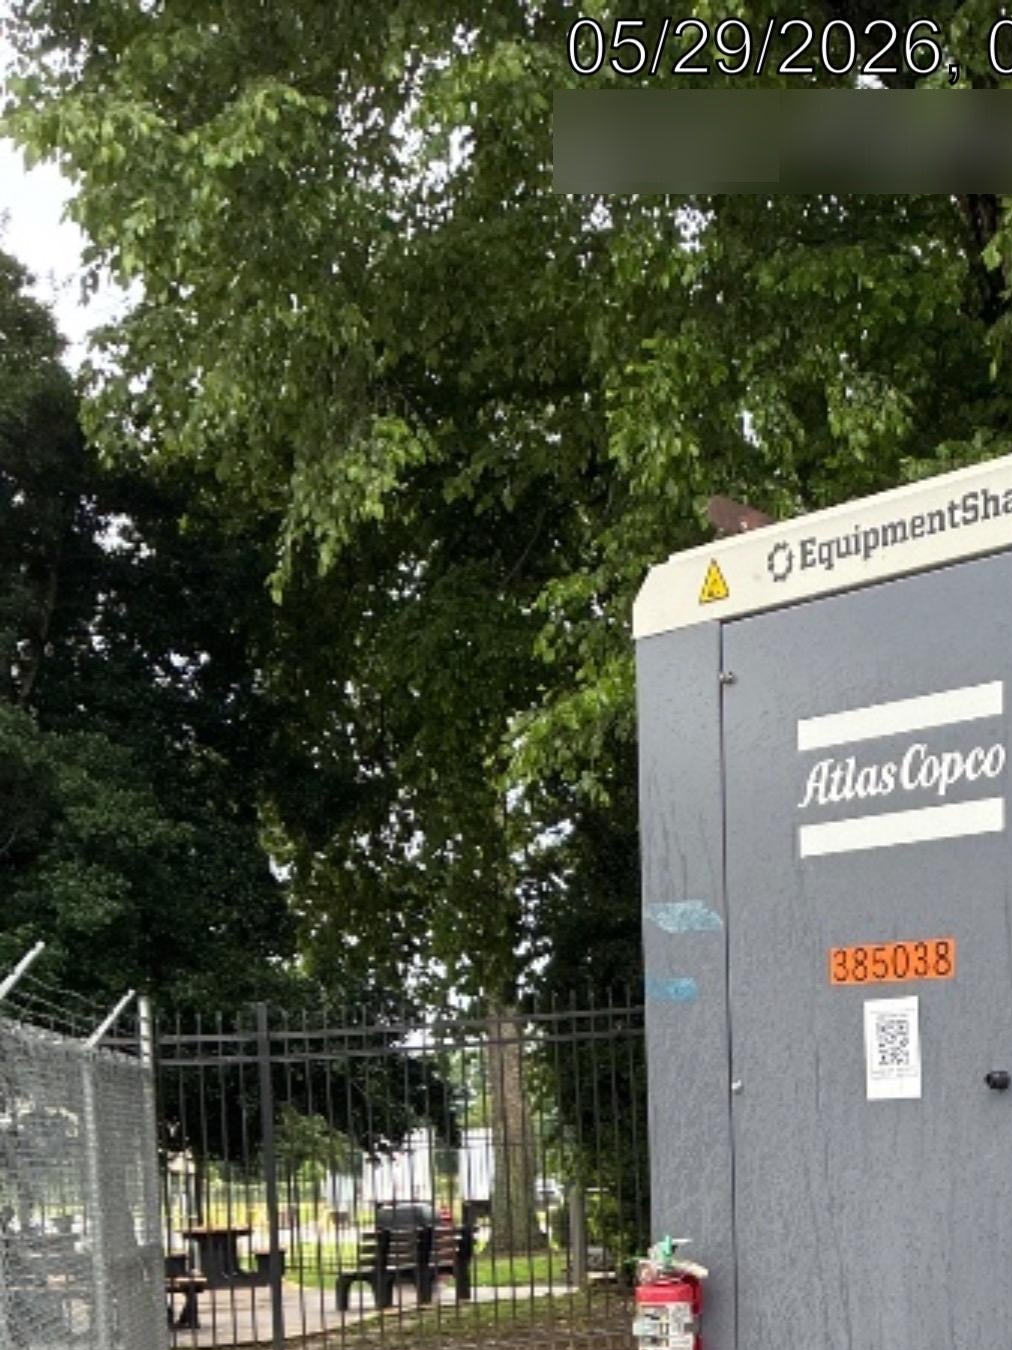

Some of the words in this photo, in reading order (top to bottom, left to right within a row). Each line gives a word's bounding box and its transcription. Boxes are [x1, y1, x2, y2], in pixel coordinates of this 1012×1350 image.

[798, 757, 898, 808] Atlas
[900, 743, 1006, 796] Copco
[832, 940, 953, 983] 385038
